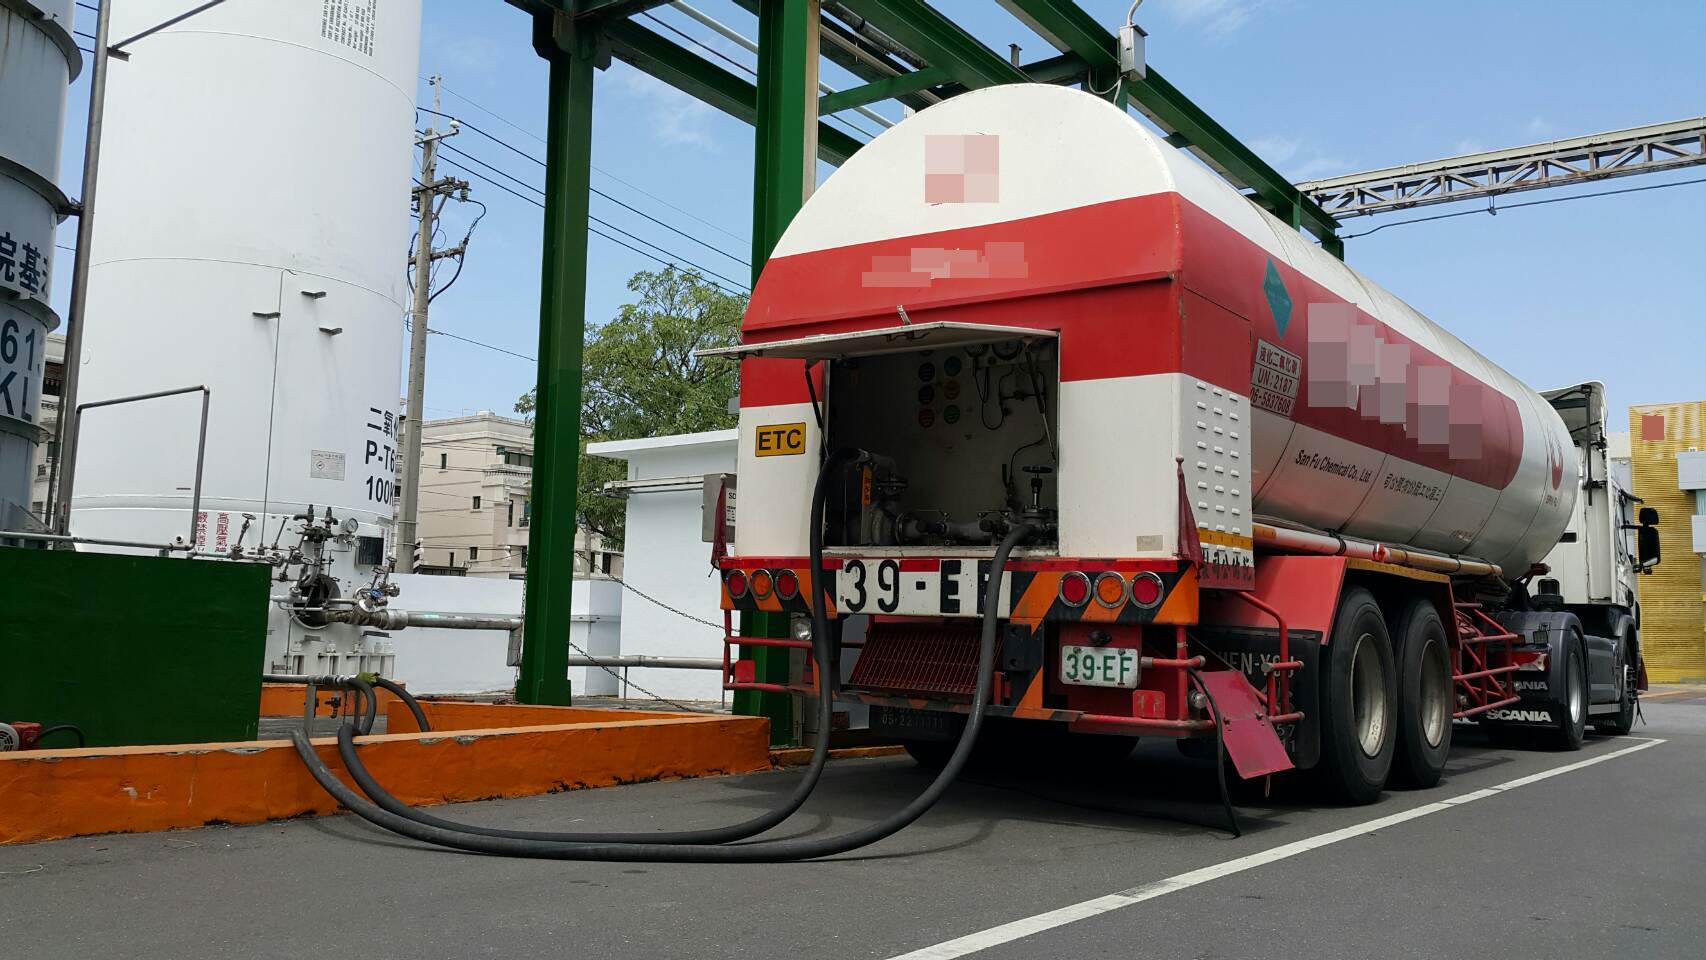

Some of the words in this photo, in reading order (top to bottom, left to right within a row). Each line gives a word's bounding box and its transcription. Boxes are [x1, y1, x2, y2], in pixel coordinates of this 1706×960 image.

[758, 429, 801, 450] ETC
[1296, 449, 1310, 466] San
[1309, 453, 1321, 469] Fu
[1319, 456, 1351, 477] Chemical
[1066, 654, 1132, 683] 39-EF
[1486, 709, 1552, 722] SCANIA
